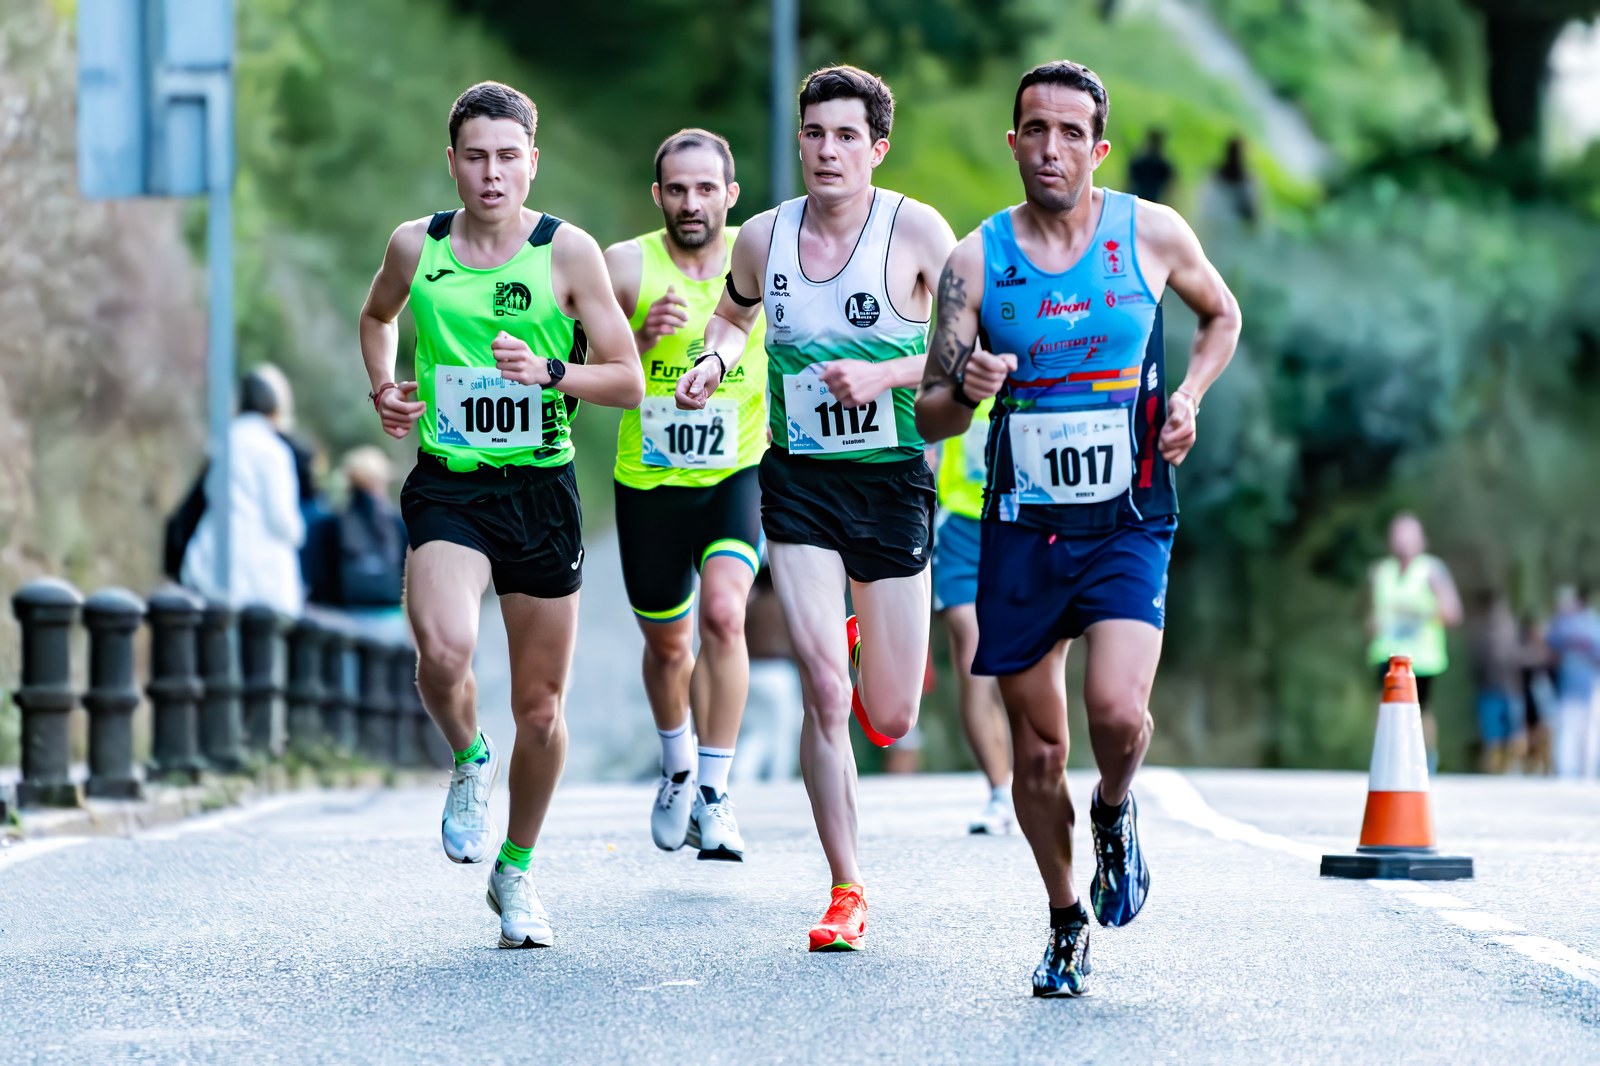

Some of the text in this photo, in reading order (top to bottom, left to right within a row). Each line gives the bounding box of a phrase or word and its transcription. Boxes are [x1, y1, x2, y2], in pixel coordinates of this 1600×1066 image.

[460, 396, 530, 433] 1001
[814, 399, 880, 438] 1112
[664, 422, 725, 457] 1072
[1043, 444, 1114, 488] 1017
